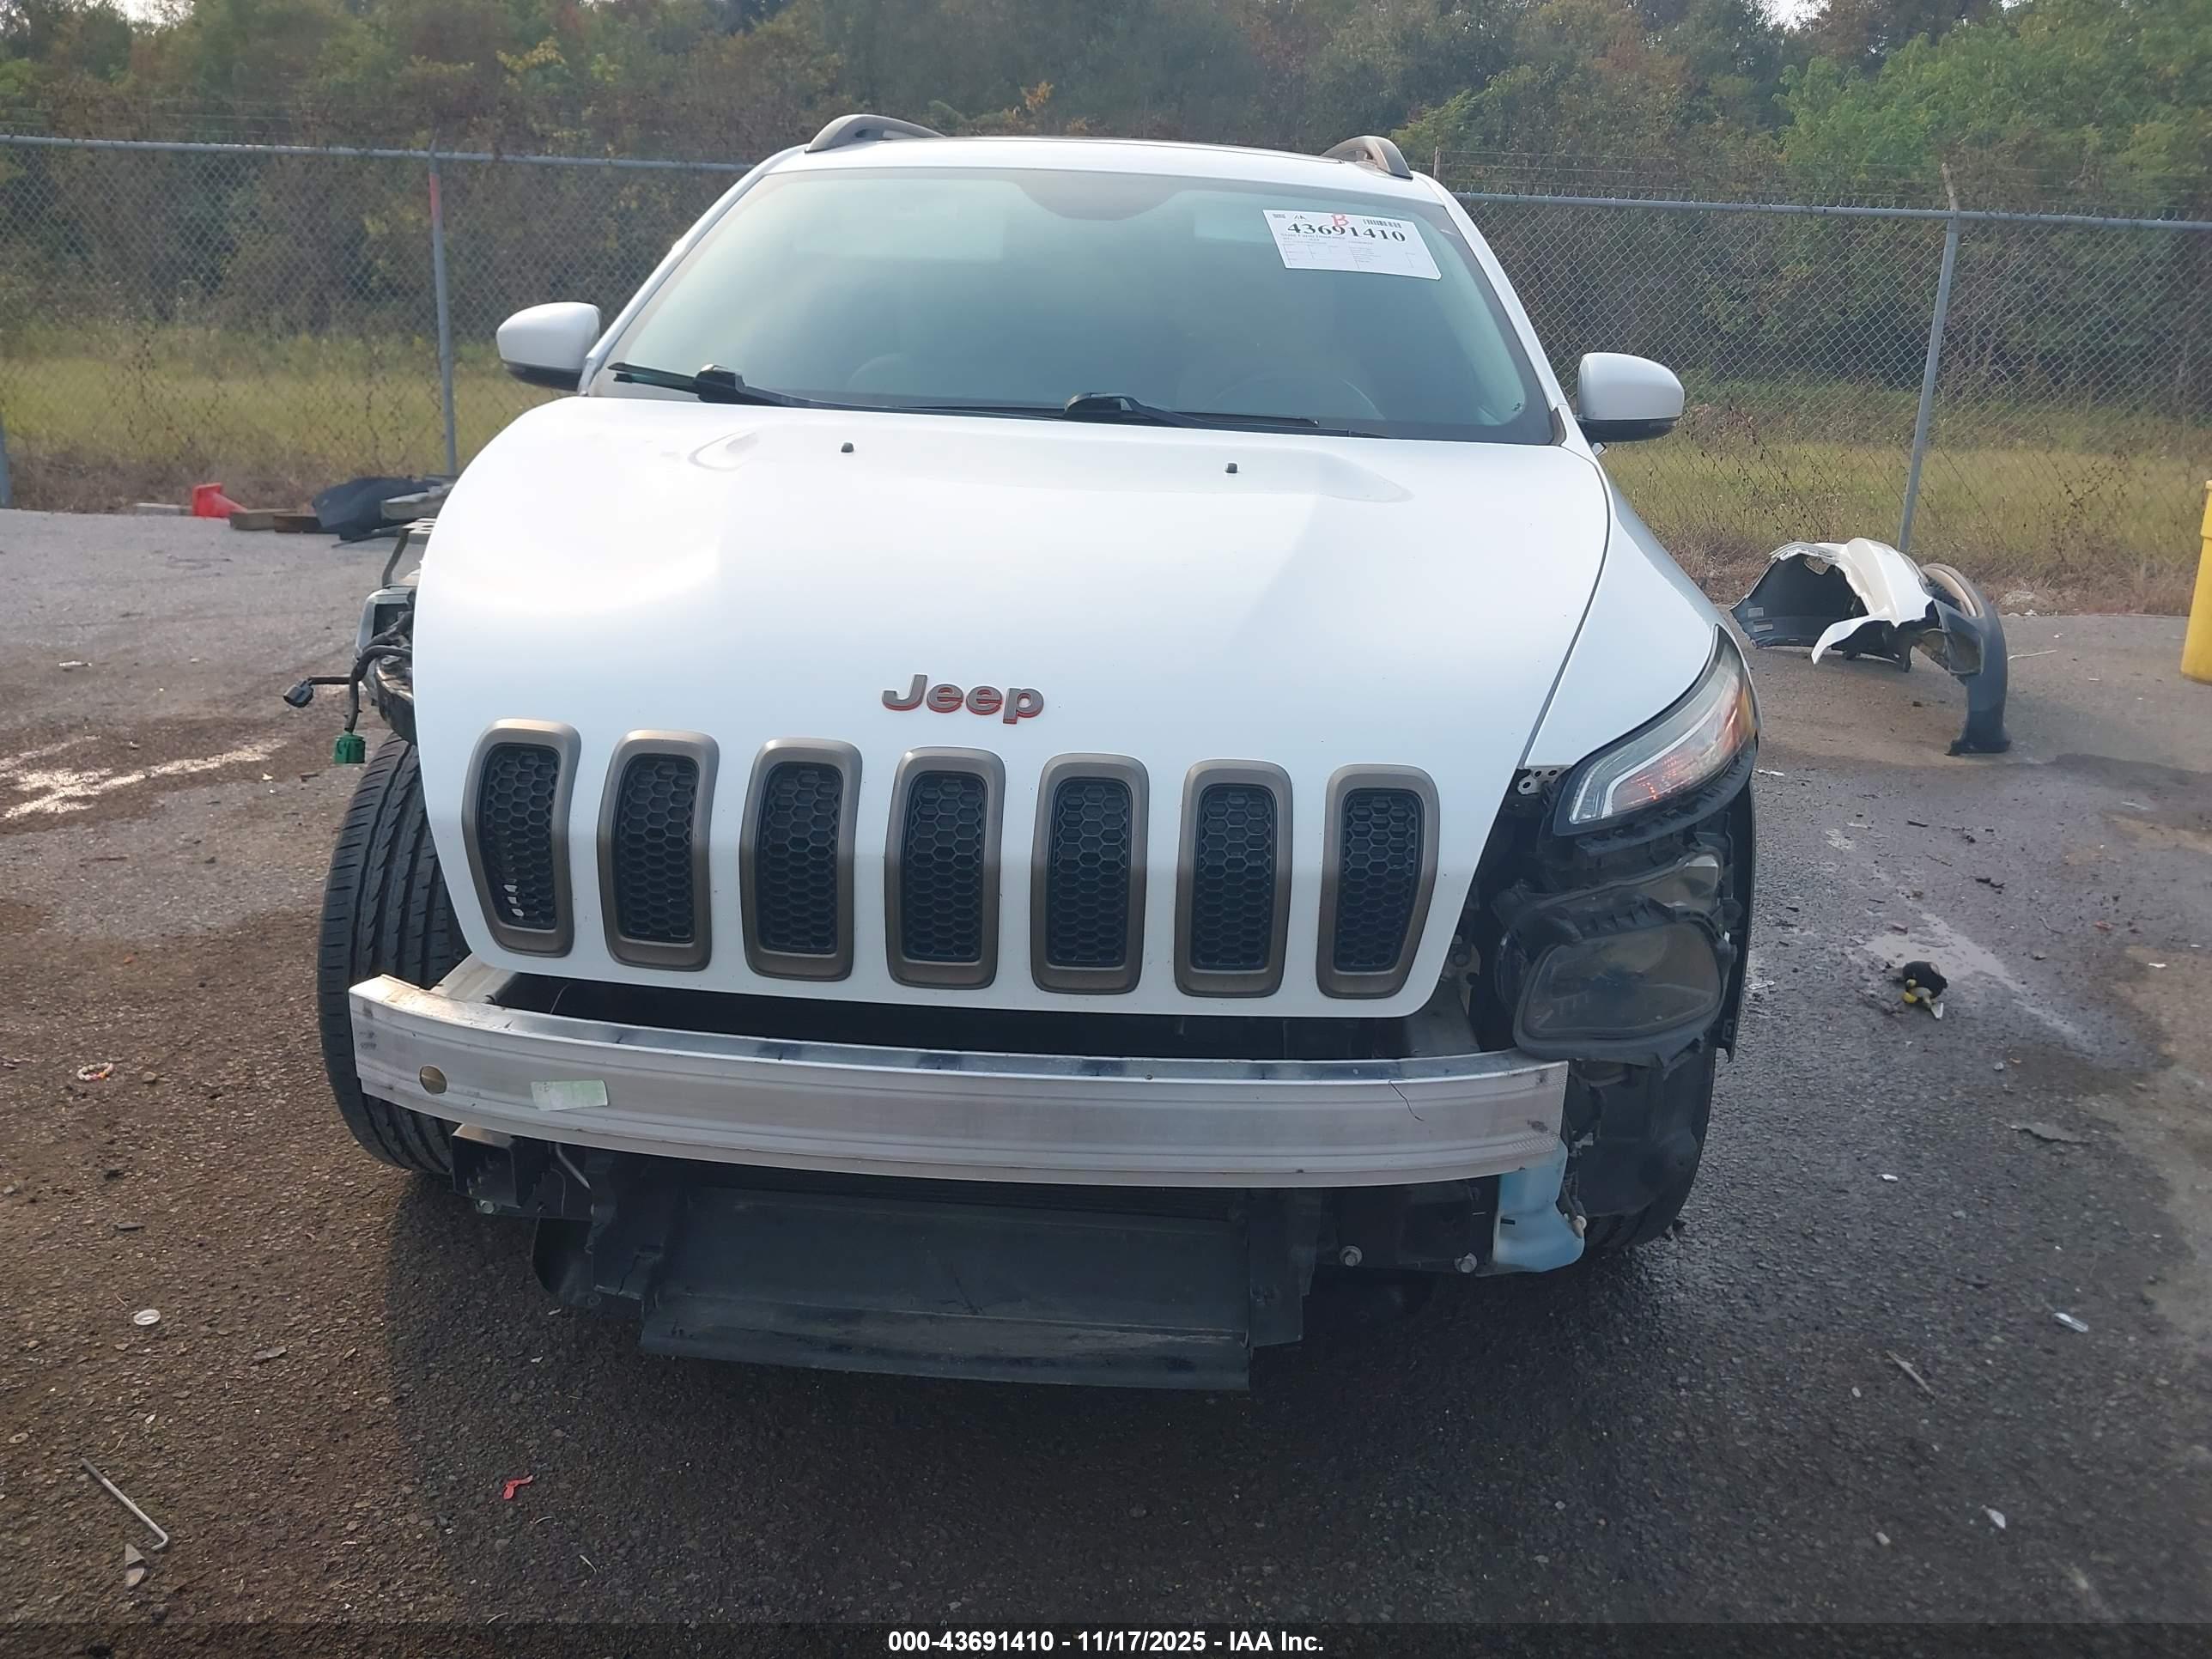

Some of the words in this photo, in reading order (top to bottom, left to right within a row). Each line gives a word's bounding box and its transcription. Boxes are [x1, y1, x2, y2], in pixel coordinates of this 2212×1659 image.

[1331, 213, 1350, 227] B
[1287, 223, 1407, 242] 43691410
[881, 674, 1044, 725] Jeep
